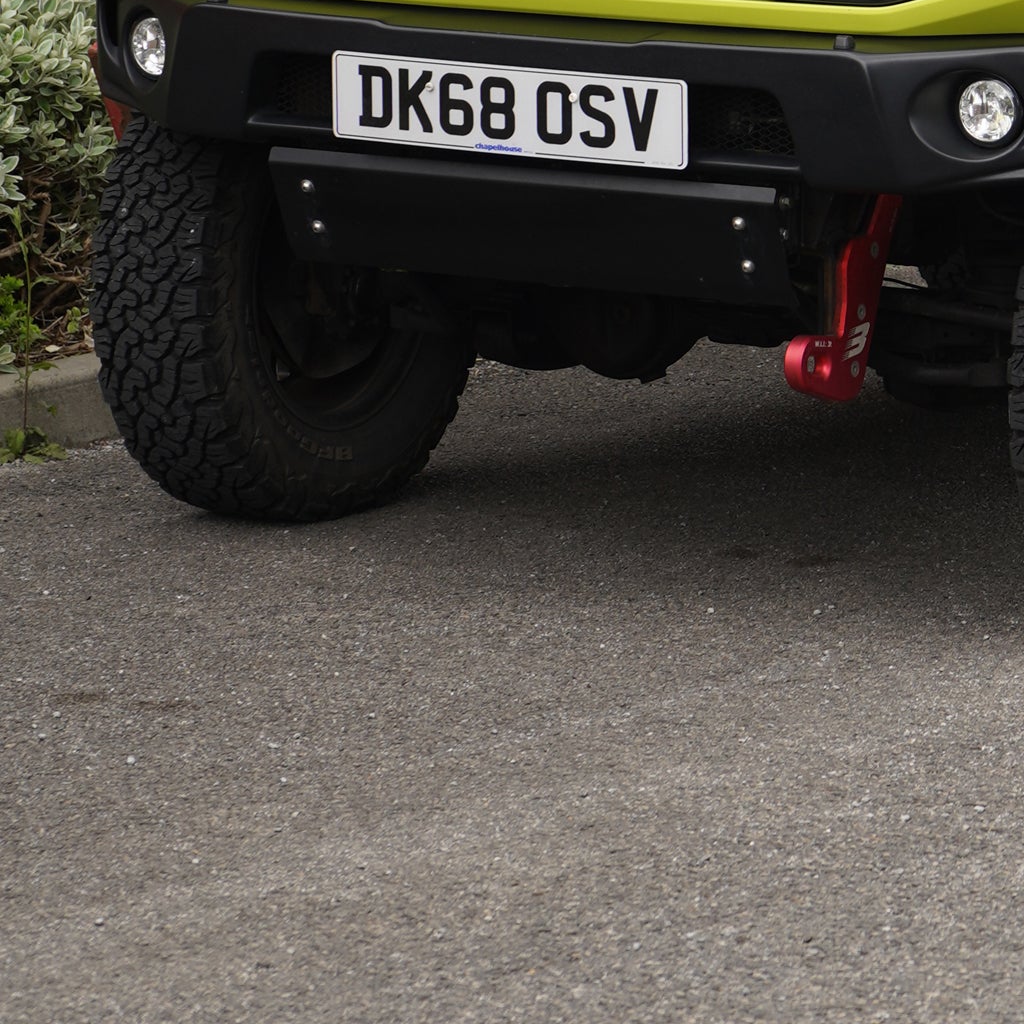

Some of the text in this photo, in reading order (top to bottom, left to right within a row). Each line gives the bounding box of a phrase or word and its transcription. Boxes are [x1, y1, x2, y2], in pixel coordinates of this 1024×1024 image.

[358, 63, 659, 152] DK68 OSV
[474, 142, 523, 153] chapelhouse
